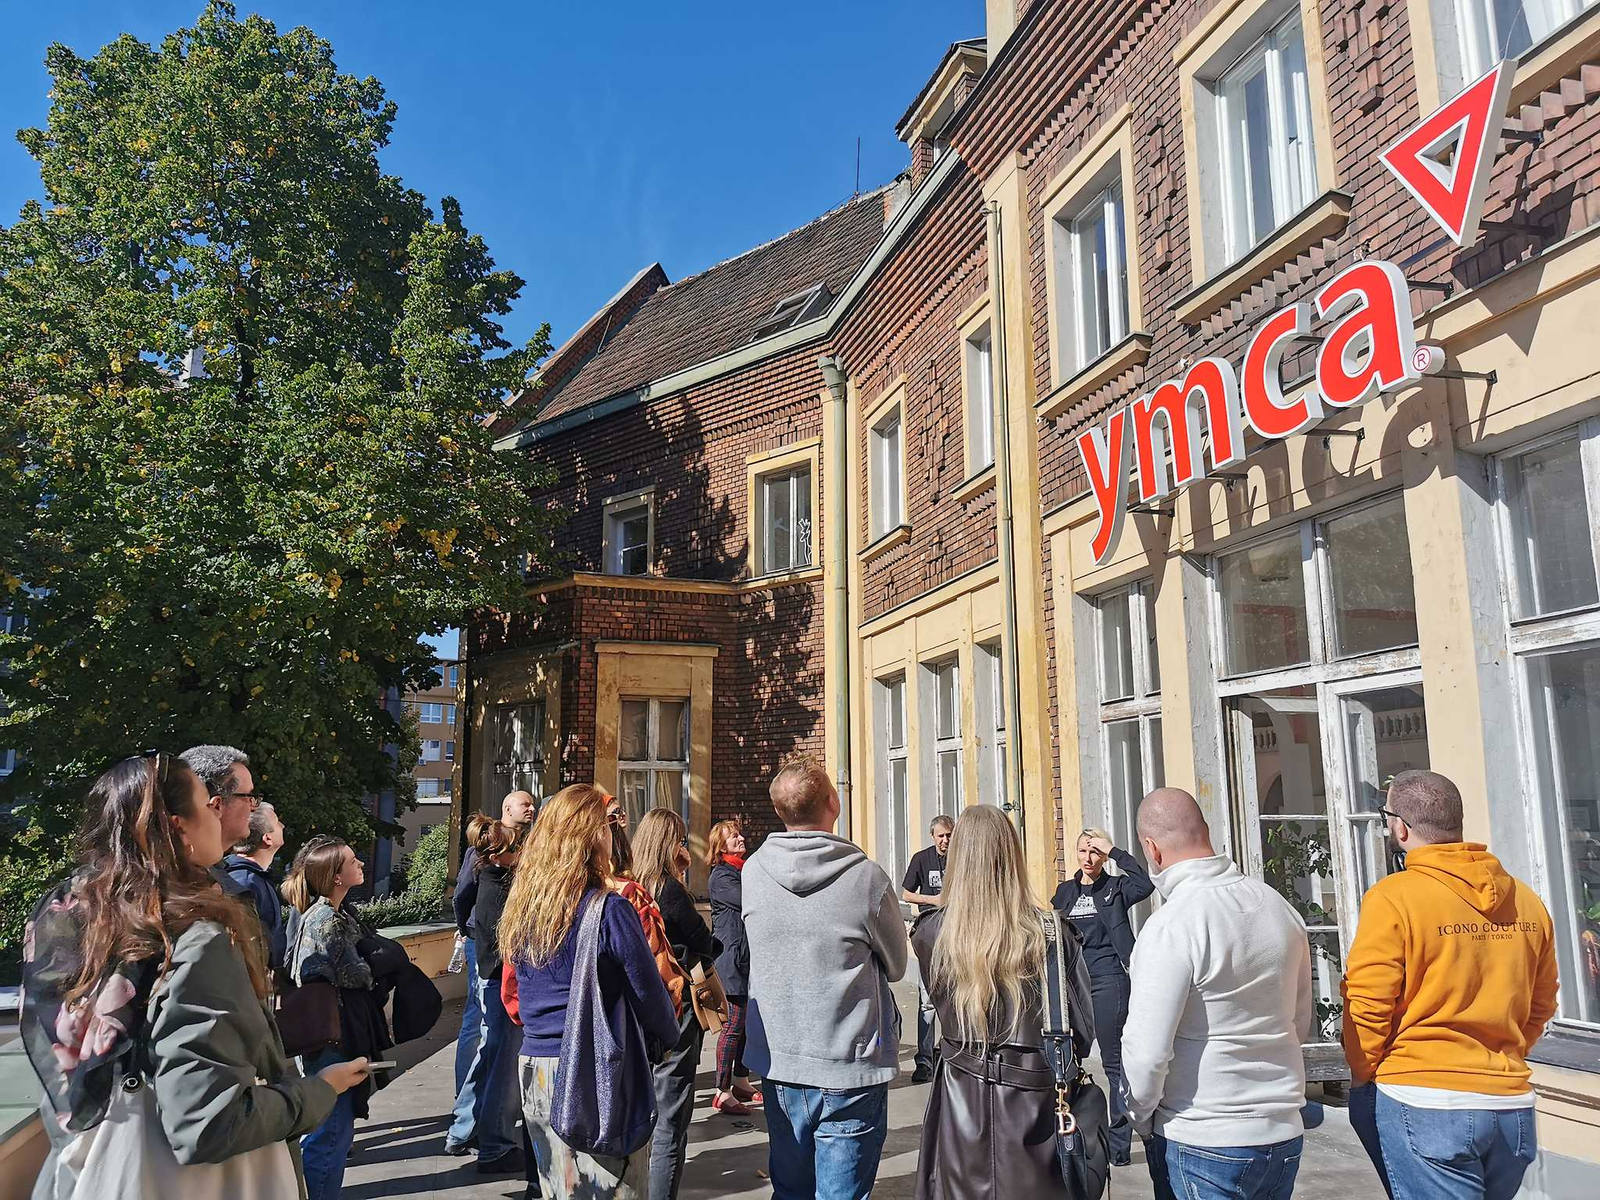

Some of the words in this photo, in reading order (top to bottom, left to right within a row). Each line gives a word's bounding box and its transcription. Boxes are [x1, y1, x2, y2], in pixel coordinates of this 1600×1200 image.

[1076, 260, 1416, 565] ymca
[1437, 922, 1478, 937] ICONO
[1482, 921, 1538, 933] COUTURE
[1491, 933, 1513, 941] TOKIO
